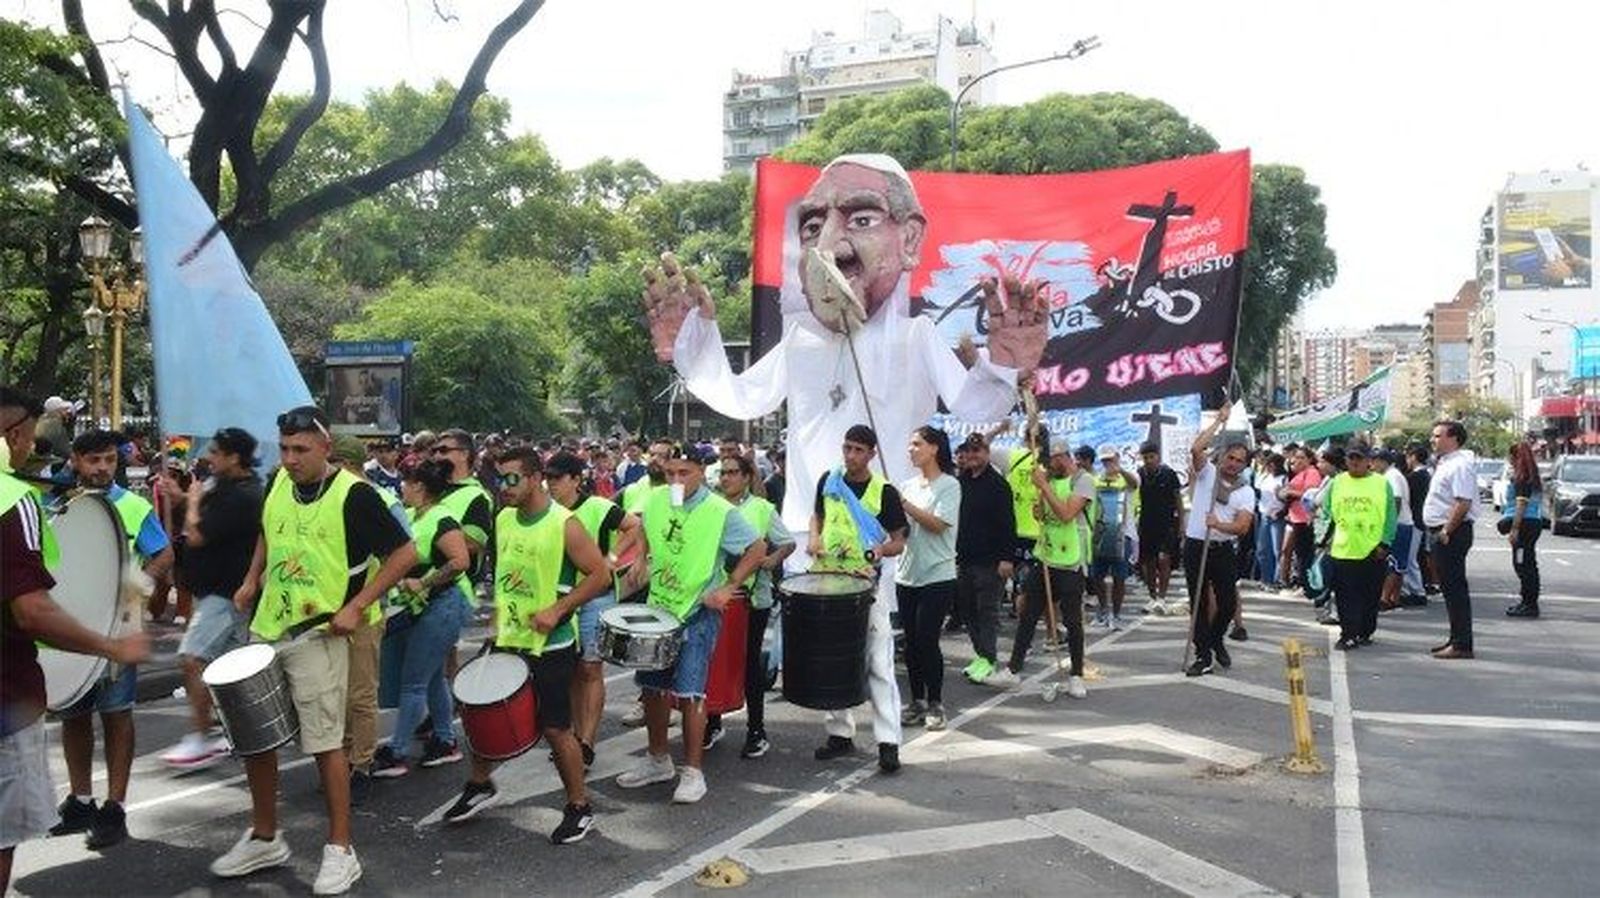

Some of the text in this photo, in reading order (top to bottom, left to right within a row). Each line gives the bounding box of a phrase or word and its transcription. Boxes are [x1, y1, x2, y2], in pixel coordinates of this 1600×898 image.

[1162, 241, 1218, 269] HOGAR
[1178, 253, 1234, 279] CRISTO
[1034, 364, 1091, 396] MO
